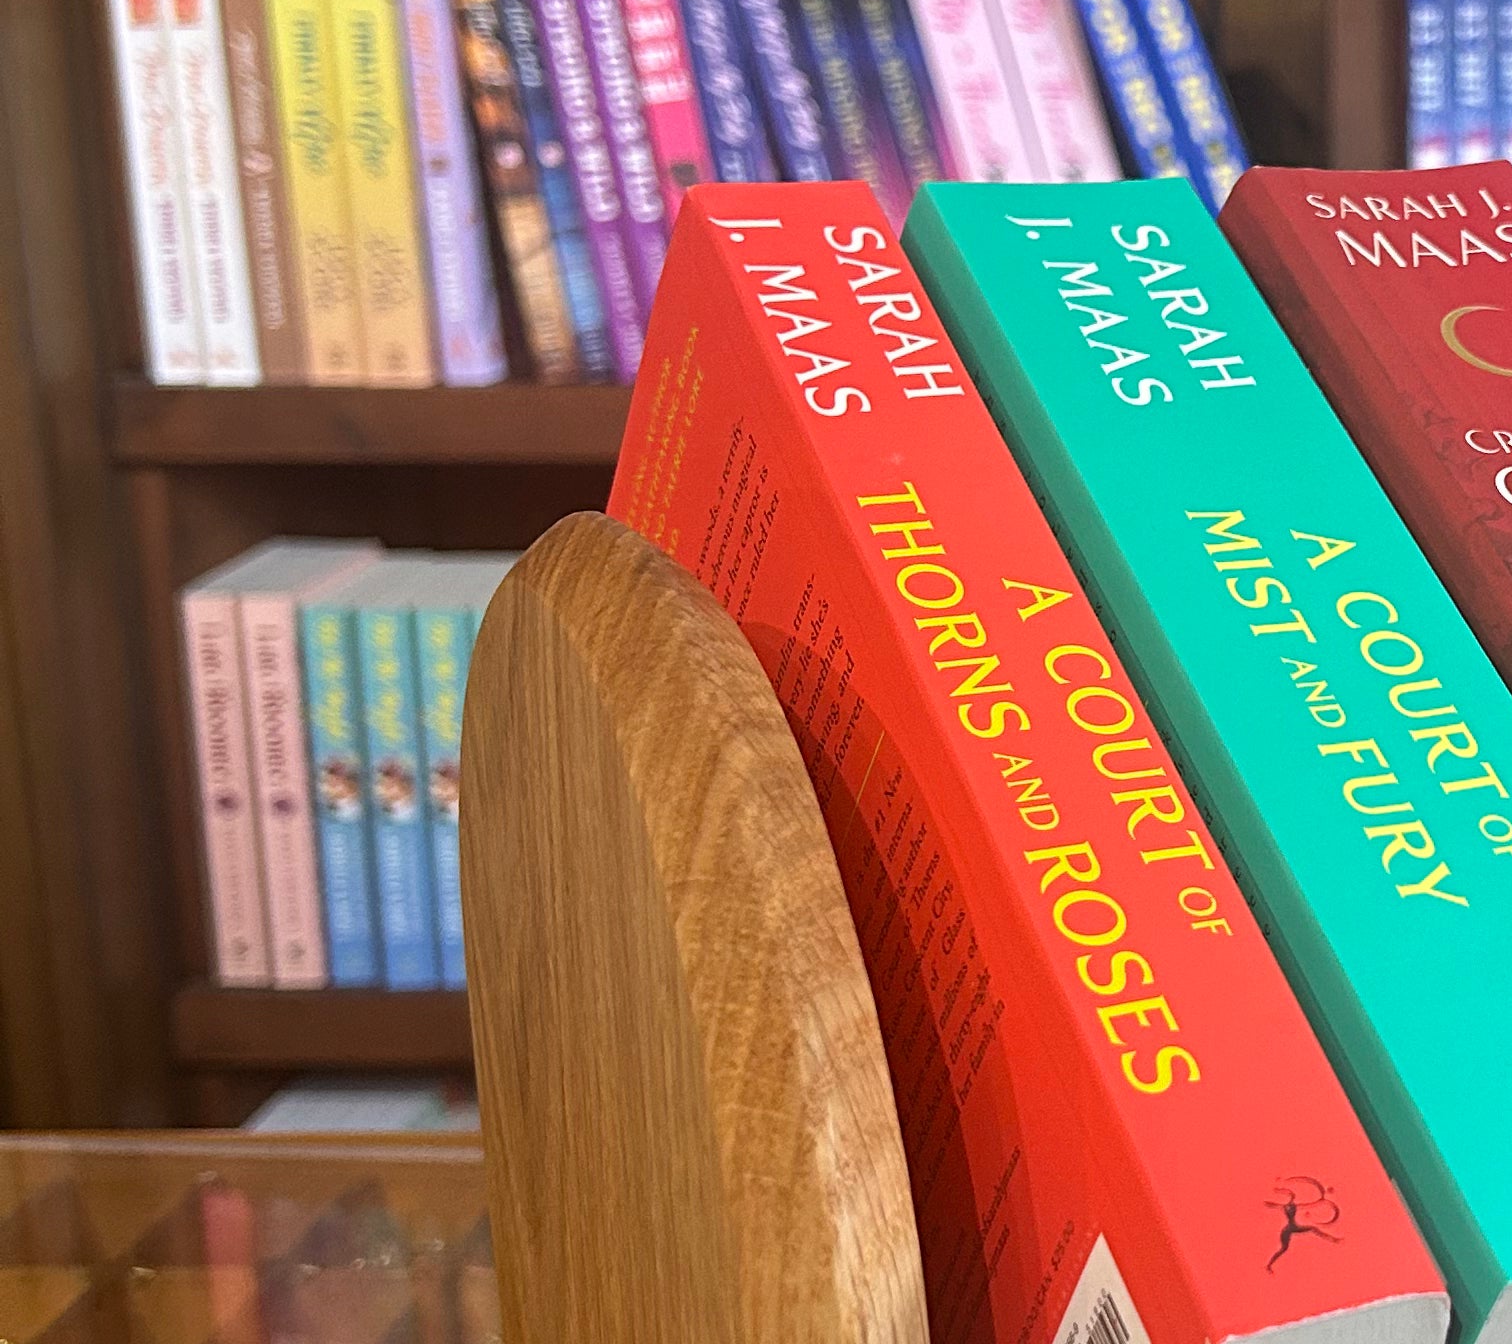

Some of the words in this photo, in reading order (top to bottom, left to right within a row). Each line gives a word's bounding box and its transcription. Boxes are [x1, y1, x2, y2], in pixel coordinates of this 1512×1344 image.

[708, 215, 782, 244] J.
[1306, 193, 1467, 222] SARAH
[1478, 189, 1512, 219] J.
[677, 327, 698, 387] BOOK
[744, 264, 872, 417] MAAS
[824, 224, 965, 398] SARAH
[1005, 213, 1073, 240] J.
[1042, 259, 1173, 406] MAAS
[1111, 224, 1256, 390] SARAH
[727, 550, 741, 583] her
[741, 487, 760, 547] captor
[759, 462, 768, 483] is
[732, 435, 756, 512] magical
[750, 523, 767, 578] ruled
[763, 490, 778, 525] her
[770, 634, 795, 693] amlin,
[793, 575, 814, 630] trans-
[798, 643, 811, 671] lie
[856, 481, 1030, 739] THORNS
[1291, 528, 1356, 570] A
[1335, 591, 1510, 800] COURT
[806, 628, 842, 725] something
[837, 650, 854, 695] and
[1184, 508, 1316, 644] MIST
[1281, 656, 1347, 729] AND
[1318, 739, 1470, 908] FURY
[993, 752, 1059, 831] AND
[1001, 577, 1073, 622] A
[1043, 644, 1215, 869] COURT
[1178, 885, 1234, 937] OF
[942, 905, 965, 954] Glass
[1025, 841, 1200, 1095] ROSES
